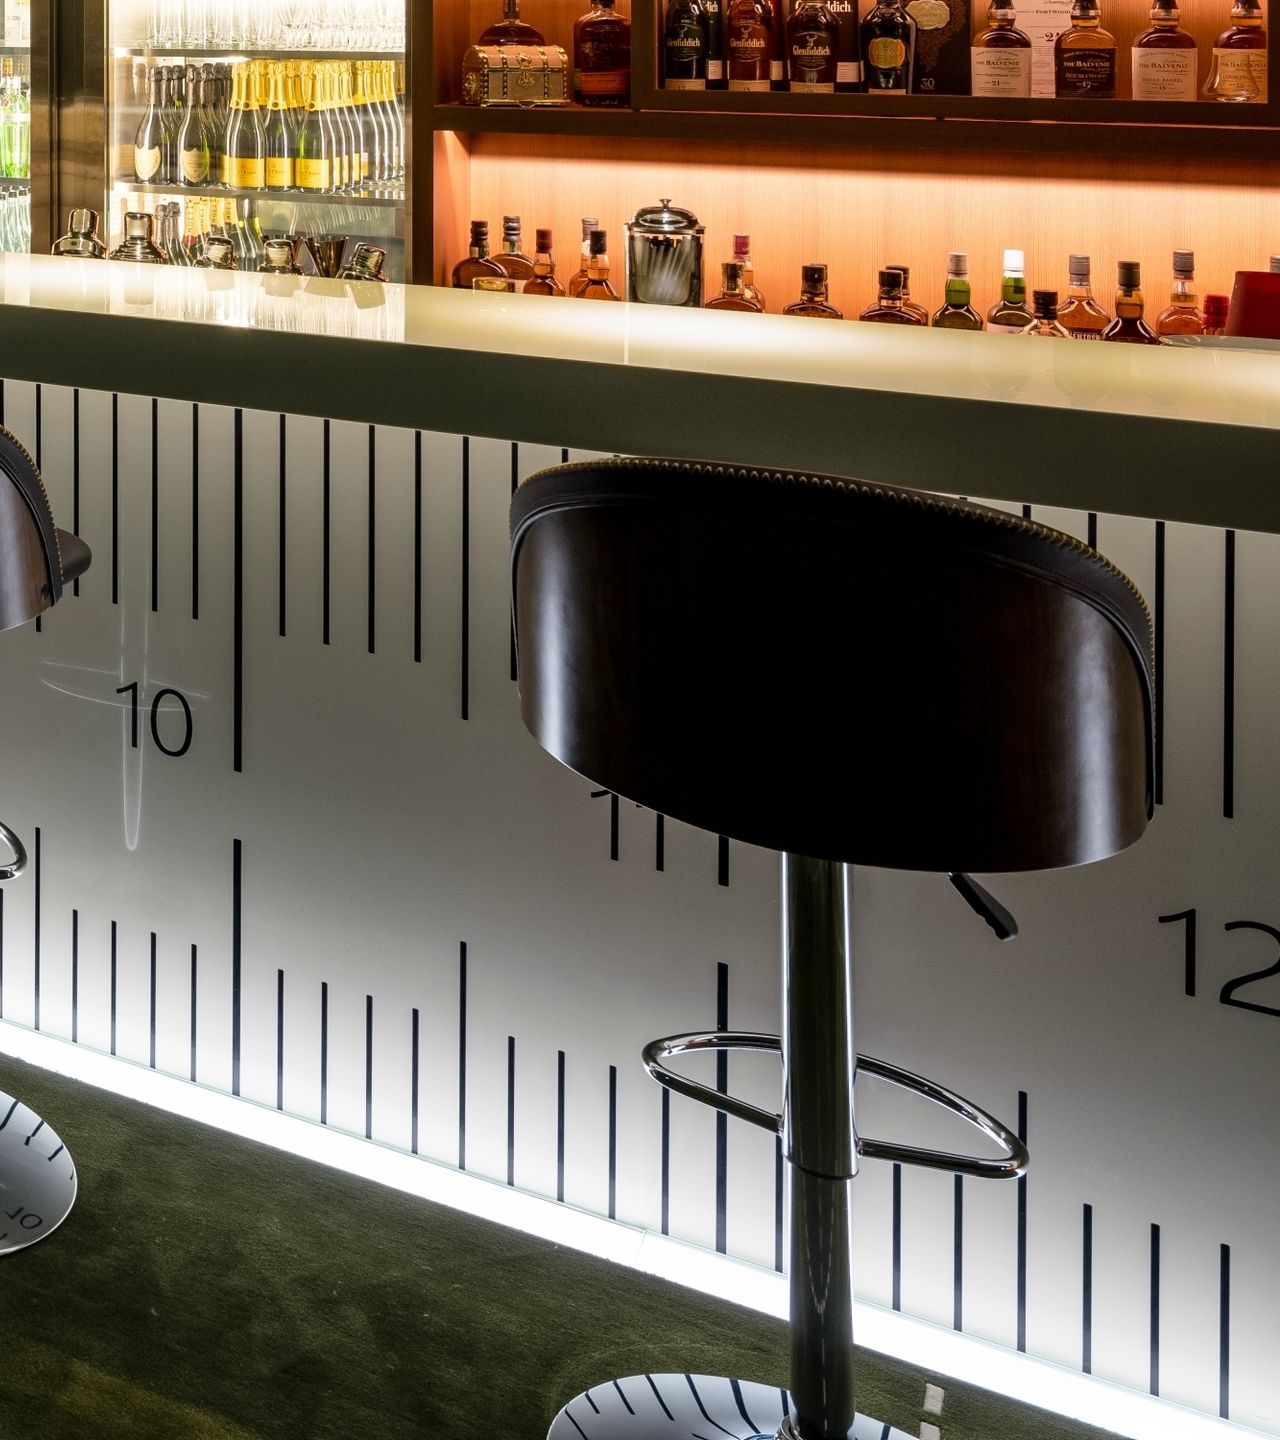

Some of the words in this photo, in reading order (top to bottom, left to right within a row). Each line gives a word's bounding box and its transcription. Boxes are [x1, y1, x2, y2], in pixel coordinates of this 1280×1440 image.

[792, 45, 831, 56] Glenfiddich
[920, 77, 936, 88] 30
[1082, 81, 1092, 89] 17
[116, 681, 193, 758] 10
[1158, 908, 1280, 1018] 12
